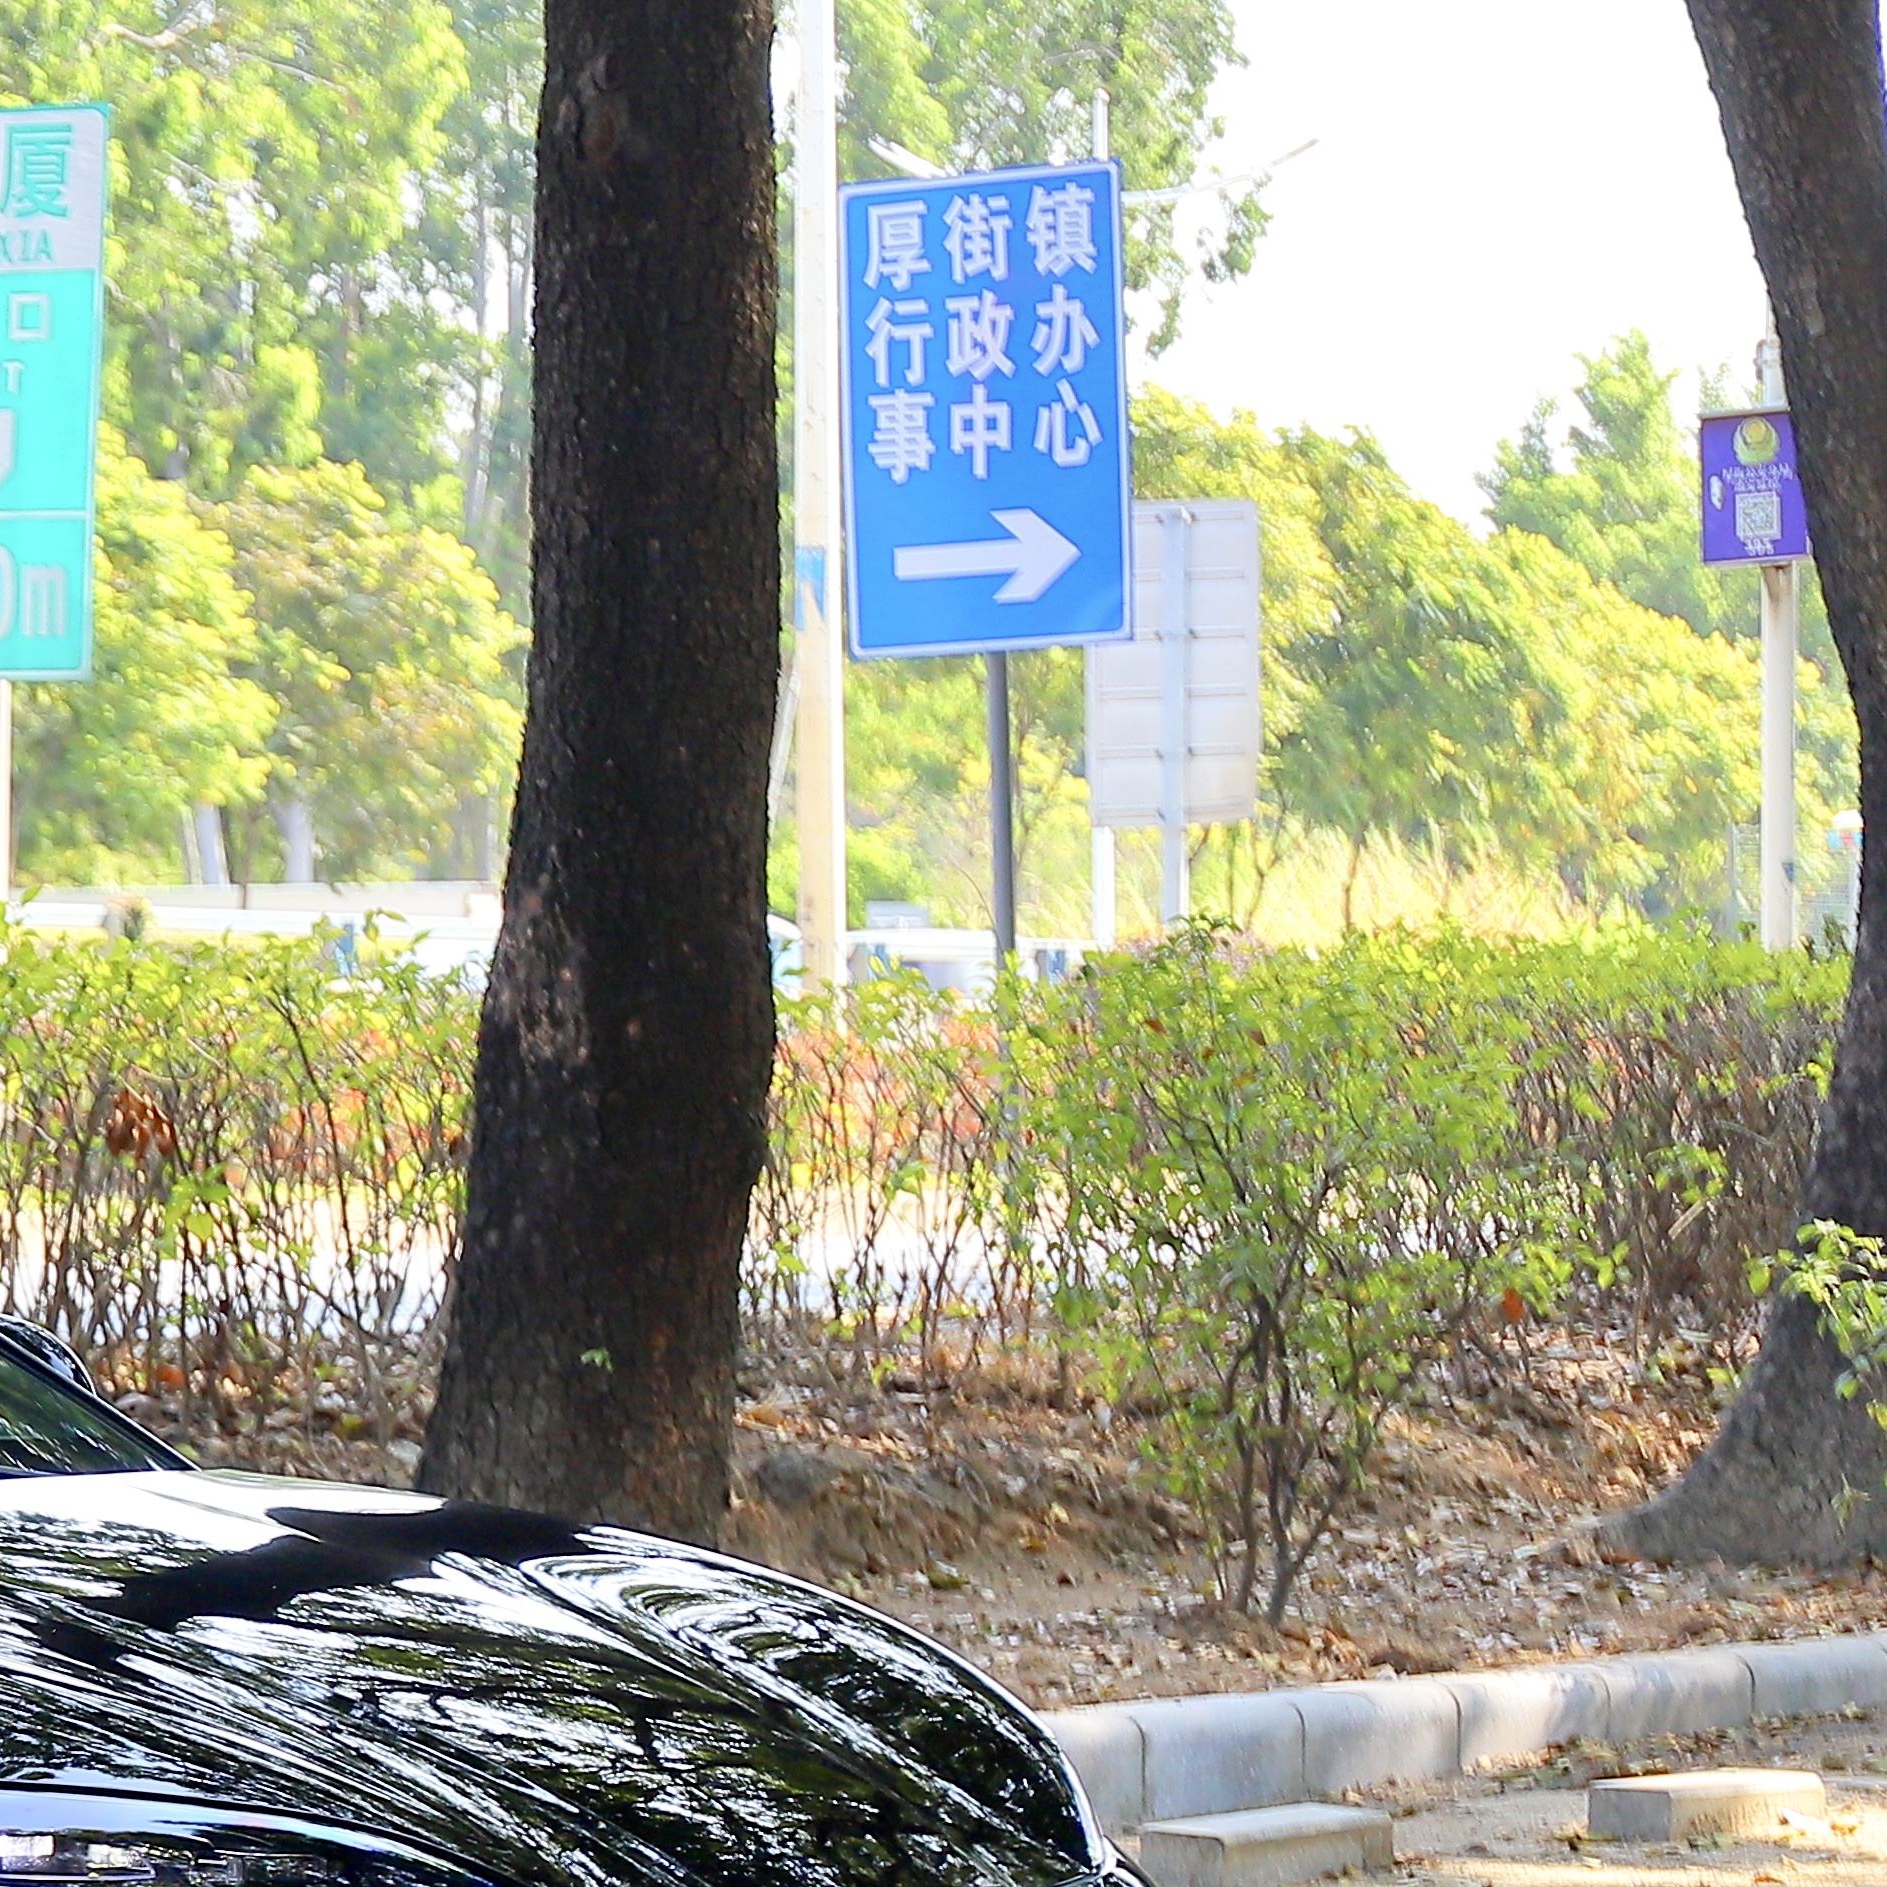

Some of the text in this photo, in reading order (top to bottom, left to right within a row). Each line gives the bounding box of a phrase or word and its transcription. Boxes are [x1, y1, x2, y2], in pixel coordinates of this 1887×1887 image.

[863, 181, 1098, 292] 厚街镇
[865, 282, 1101, 388] 行政办
[867, 378, 1103, 485] 事中心
